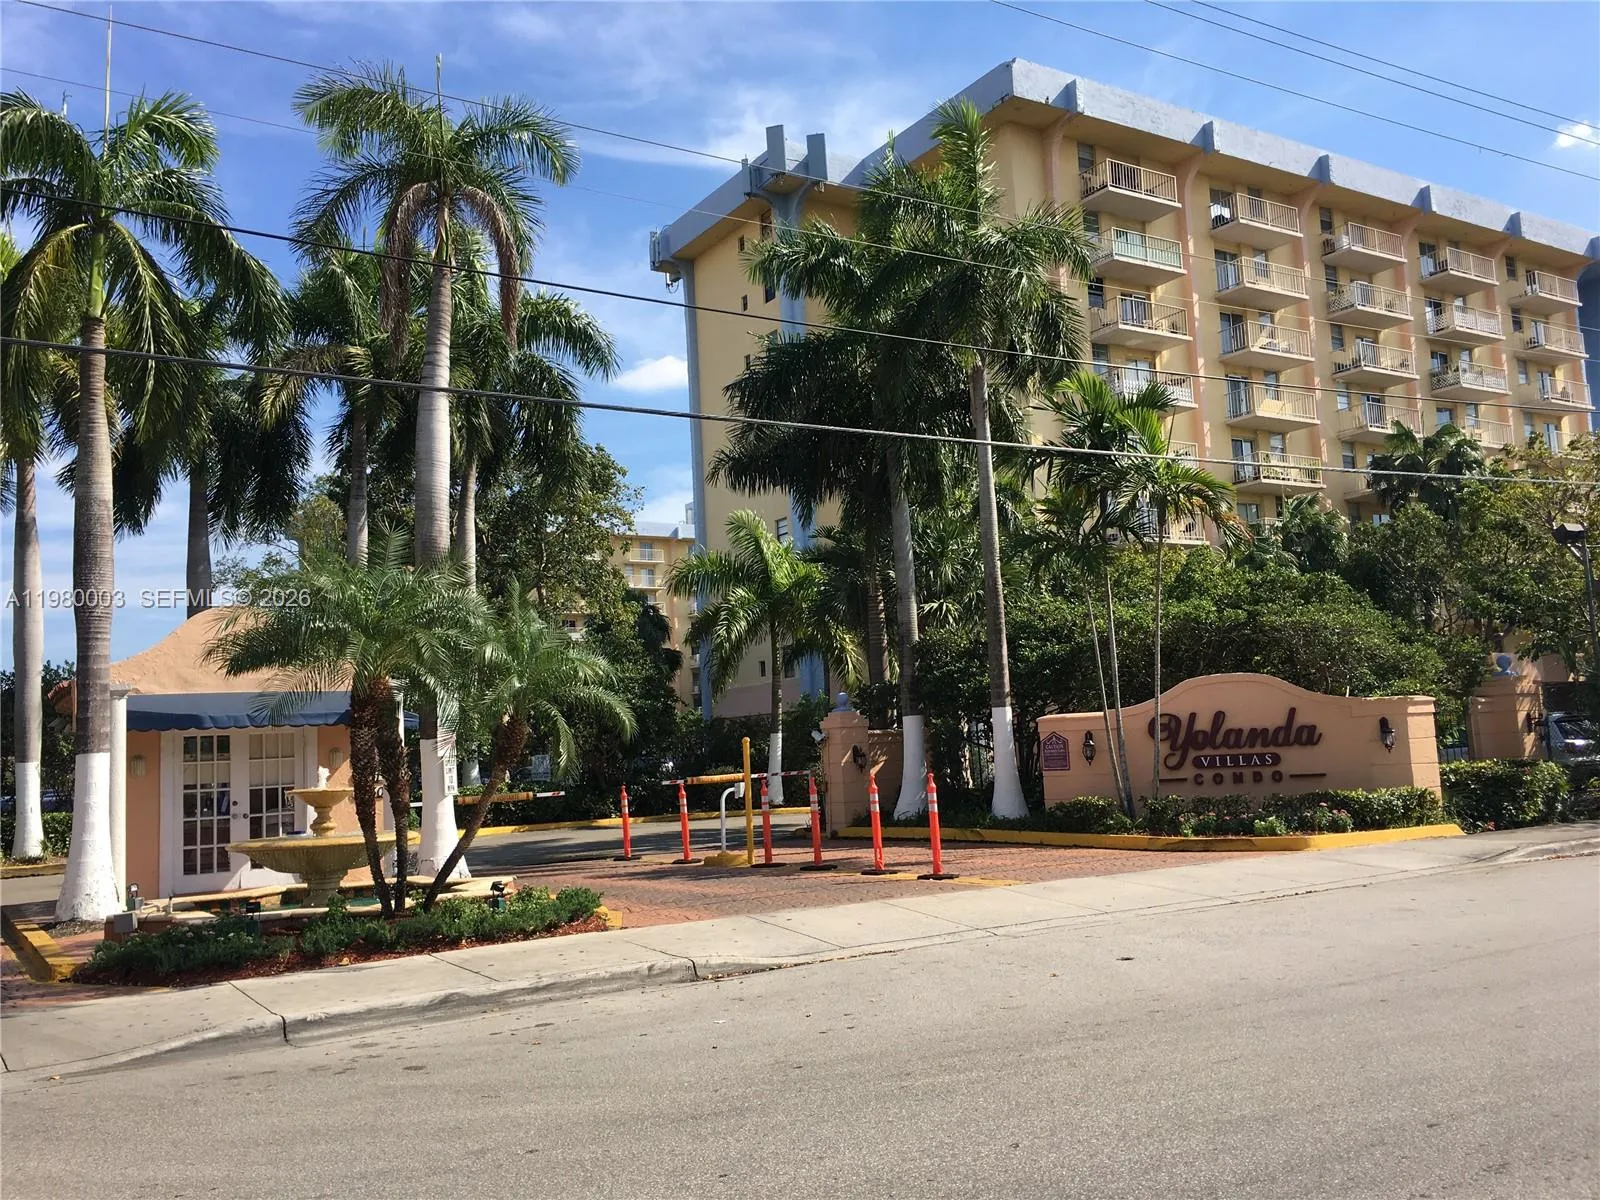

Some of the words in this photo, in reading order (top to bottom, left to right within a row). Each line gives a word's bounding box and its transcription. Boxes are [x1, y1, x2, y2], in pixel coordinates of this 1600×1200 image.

[1148, 707, 1323, 770] Yolanda
[1200, 753, 1273, 767] VILLAS
[1194, 770, 1284, 786] CONDO
